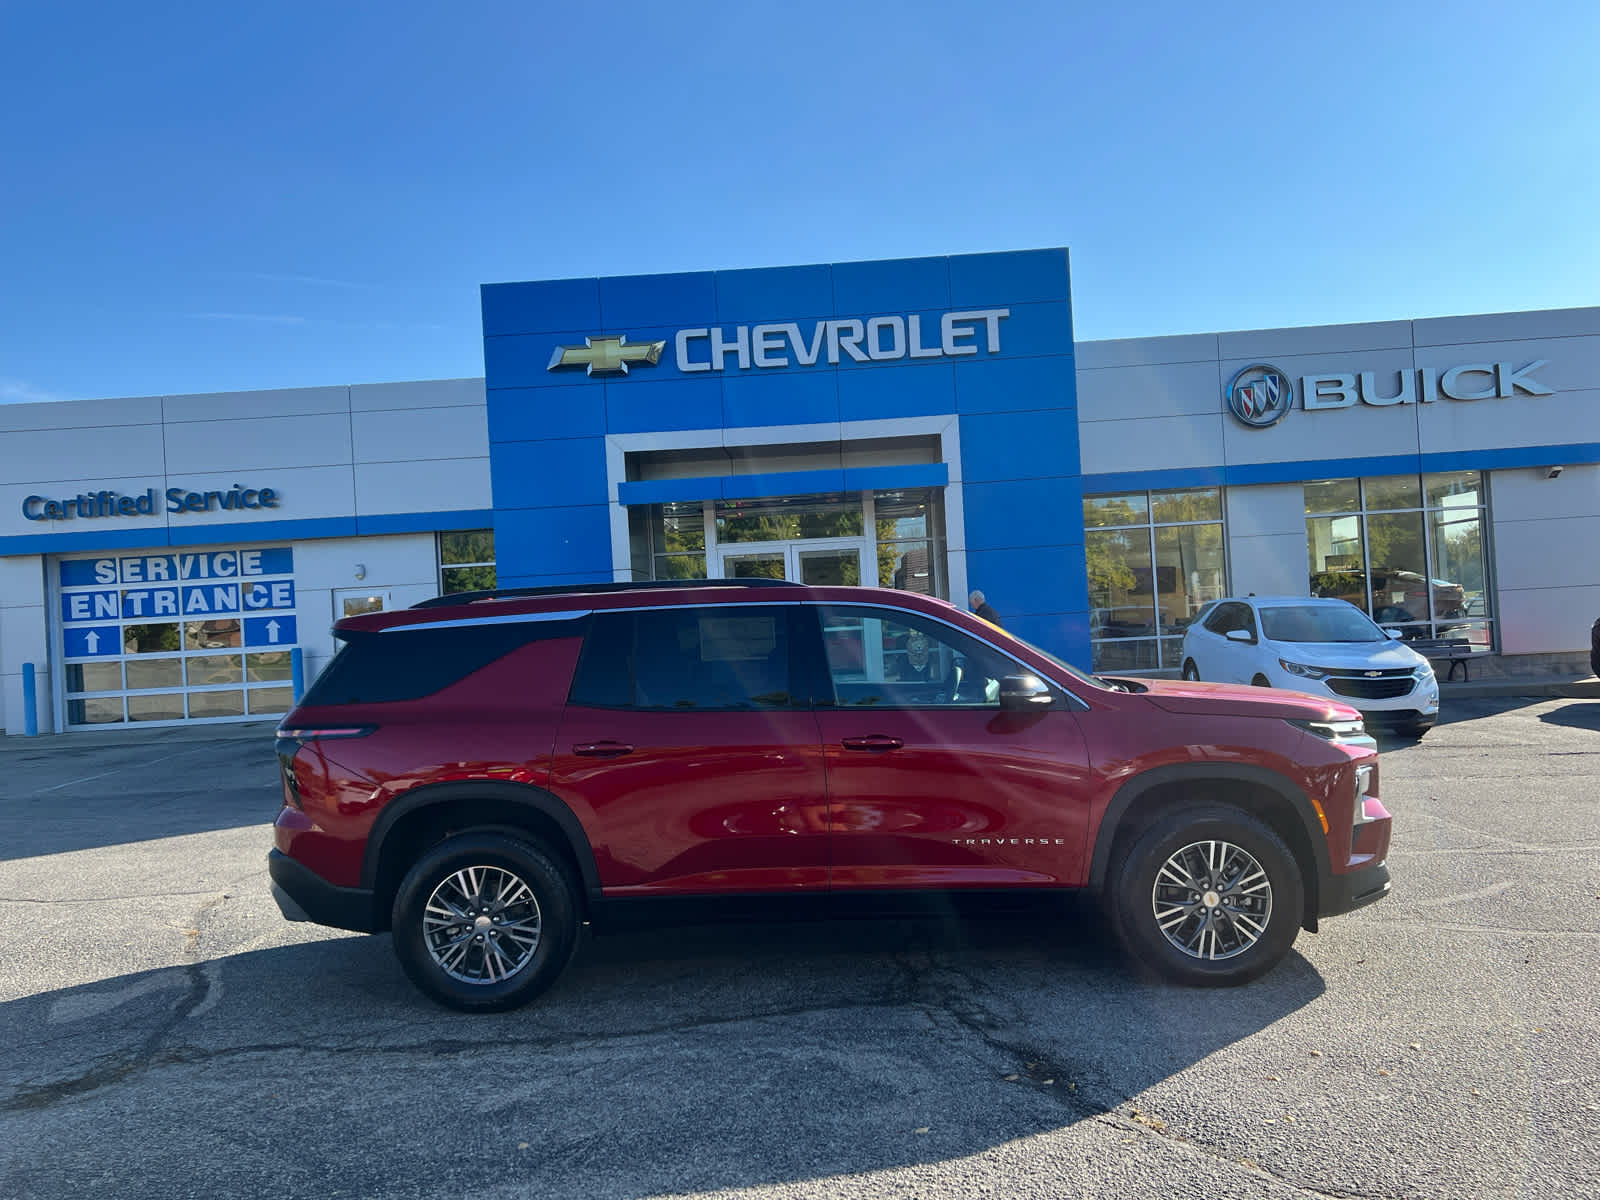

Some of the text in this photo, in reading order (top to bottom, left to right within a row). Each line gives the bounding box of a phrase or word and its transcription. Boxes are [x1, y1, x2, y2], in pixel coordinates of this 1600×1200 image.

[676, 309, 1010, 371] CHEVROLET
[1302, 360, 1553, 410] BUICK
[22, 484, 277, 521] Certified Service
[96, 551, 263, 583] SERVICE
[71, 583, 292, 619] ENTRANCE
